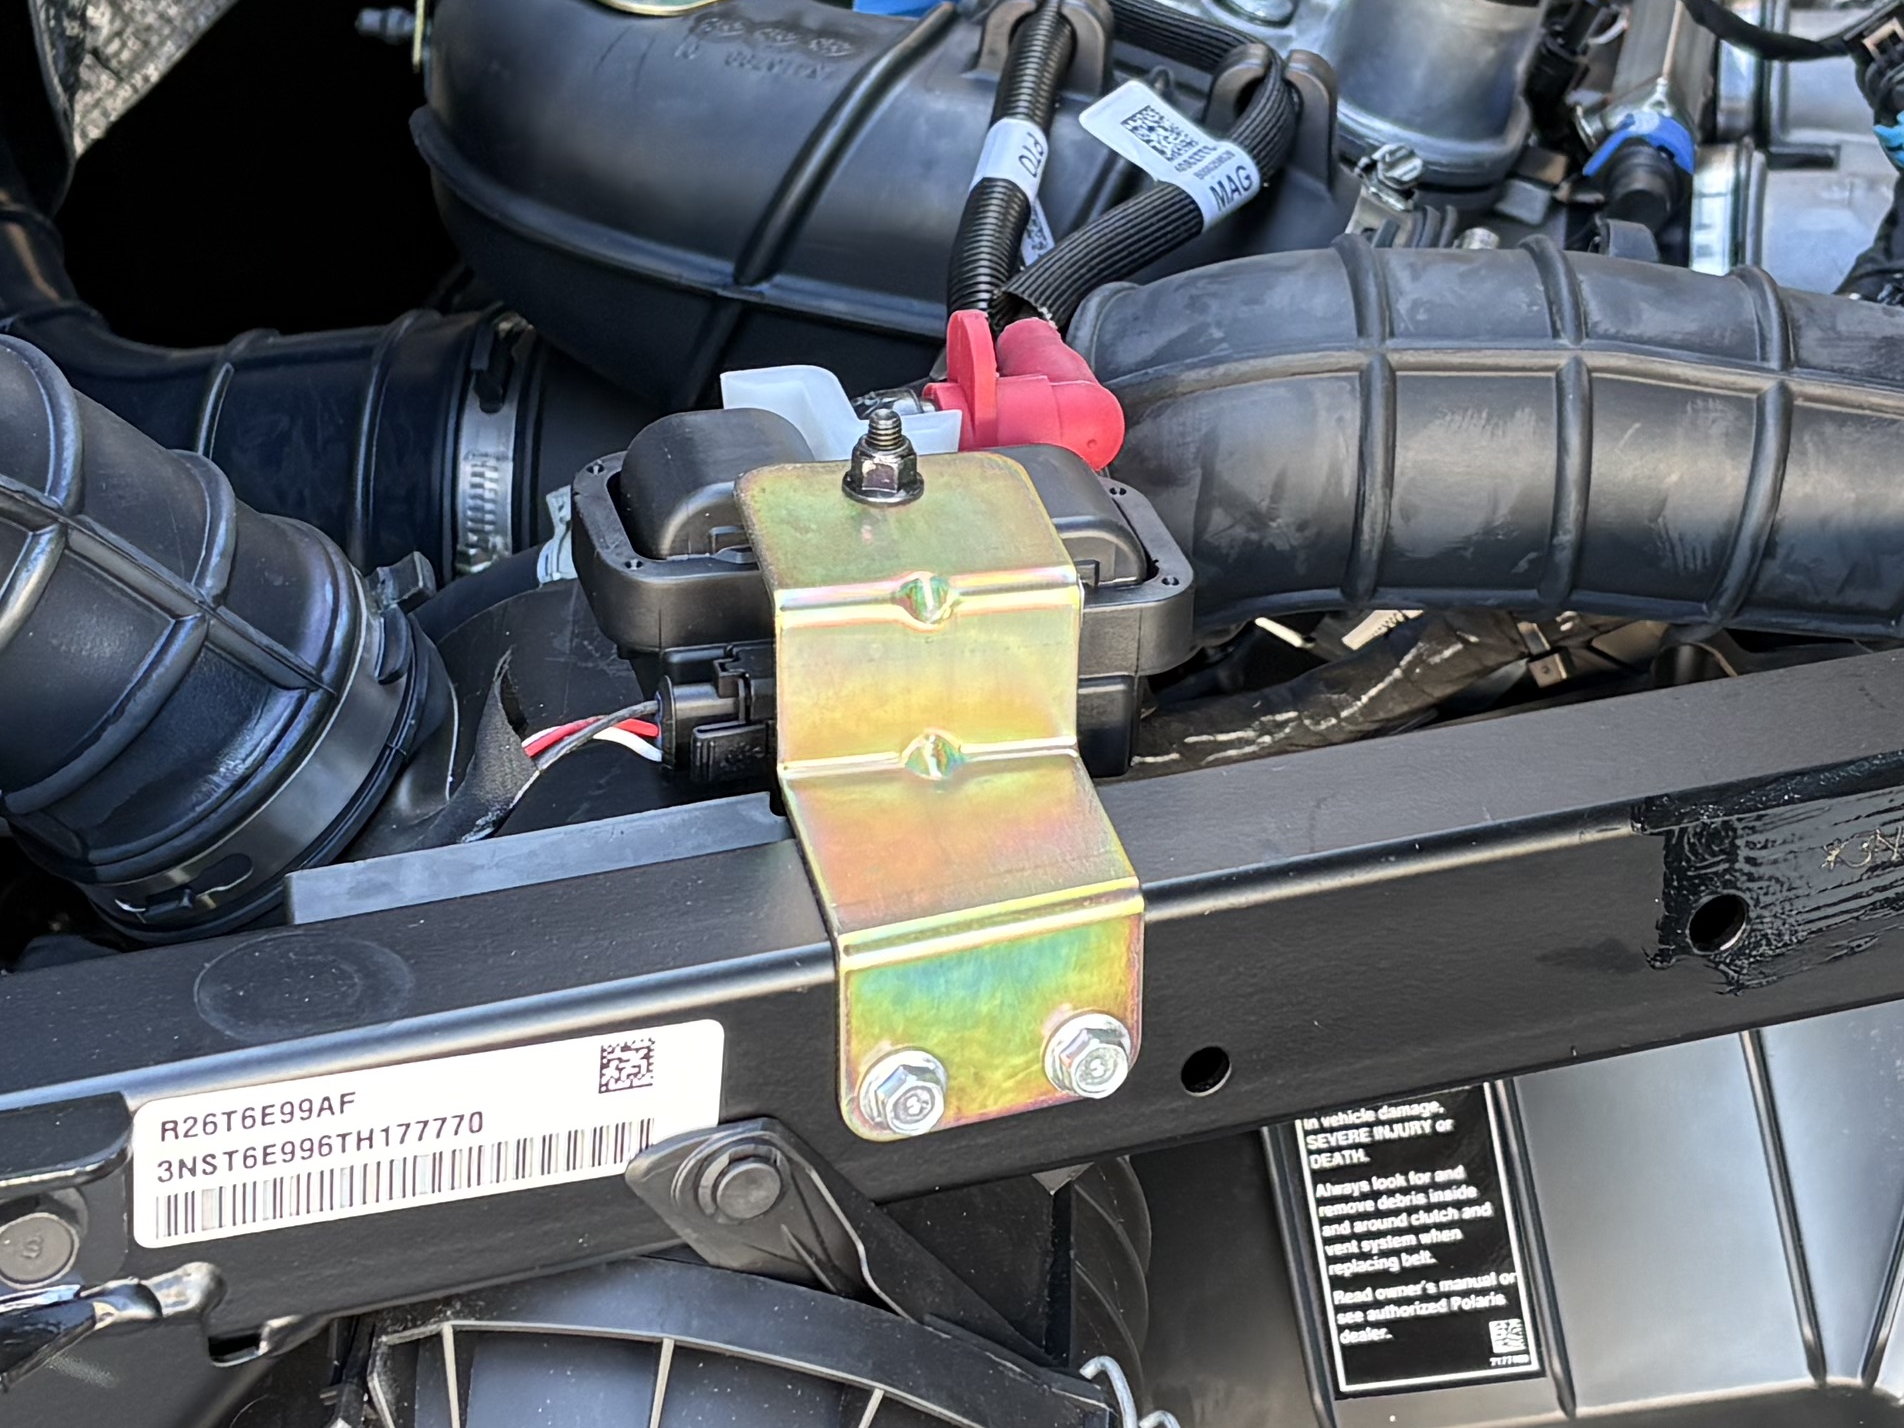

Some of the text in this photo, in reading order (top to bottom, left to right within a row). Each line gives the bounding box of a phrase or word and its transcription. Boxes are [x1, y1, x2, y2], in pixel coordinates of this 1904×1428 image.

[1209, 165, 1253, 212] MAG
[159, 1090, 357, 1143] R26T6E99AF
[1320, 1107, 1376, 1125] vehicle
[156, 1110, 485, 1184] 3NST6E996TH177770
[1306, 1119, 1455, 1150] SEVERE INJURY or
[1316, 1166, 1466, 1200] Always look for and
[1318, 1185, 1478, 1218] remove debris inside
[1321, 1202, 1494, 1237] and around clutch and
[1324, 1228, 1464, 1256] vent system when
[1328, 1250, 1439, 1278] replacing belt.
[1333, 1272, 1518, 1306] Read owner's manual or
[1336, 1292, 1507, 1324] see authorized Polaris
[1340, 1325, 1394, 1344] dealer.
